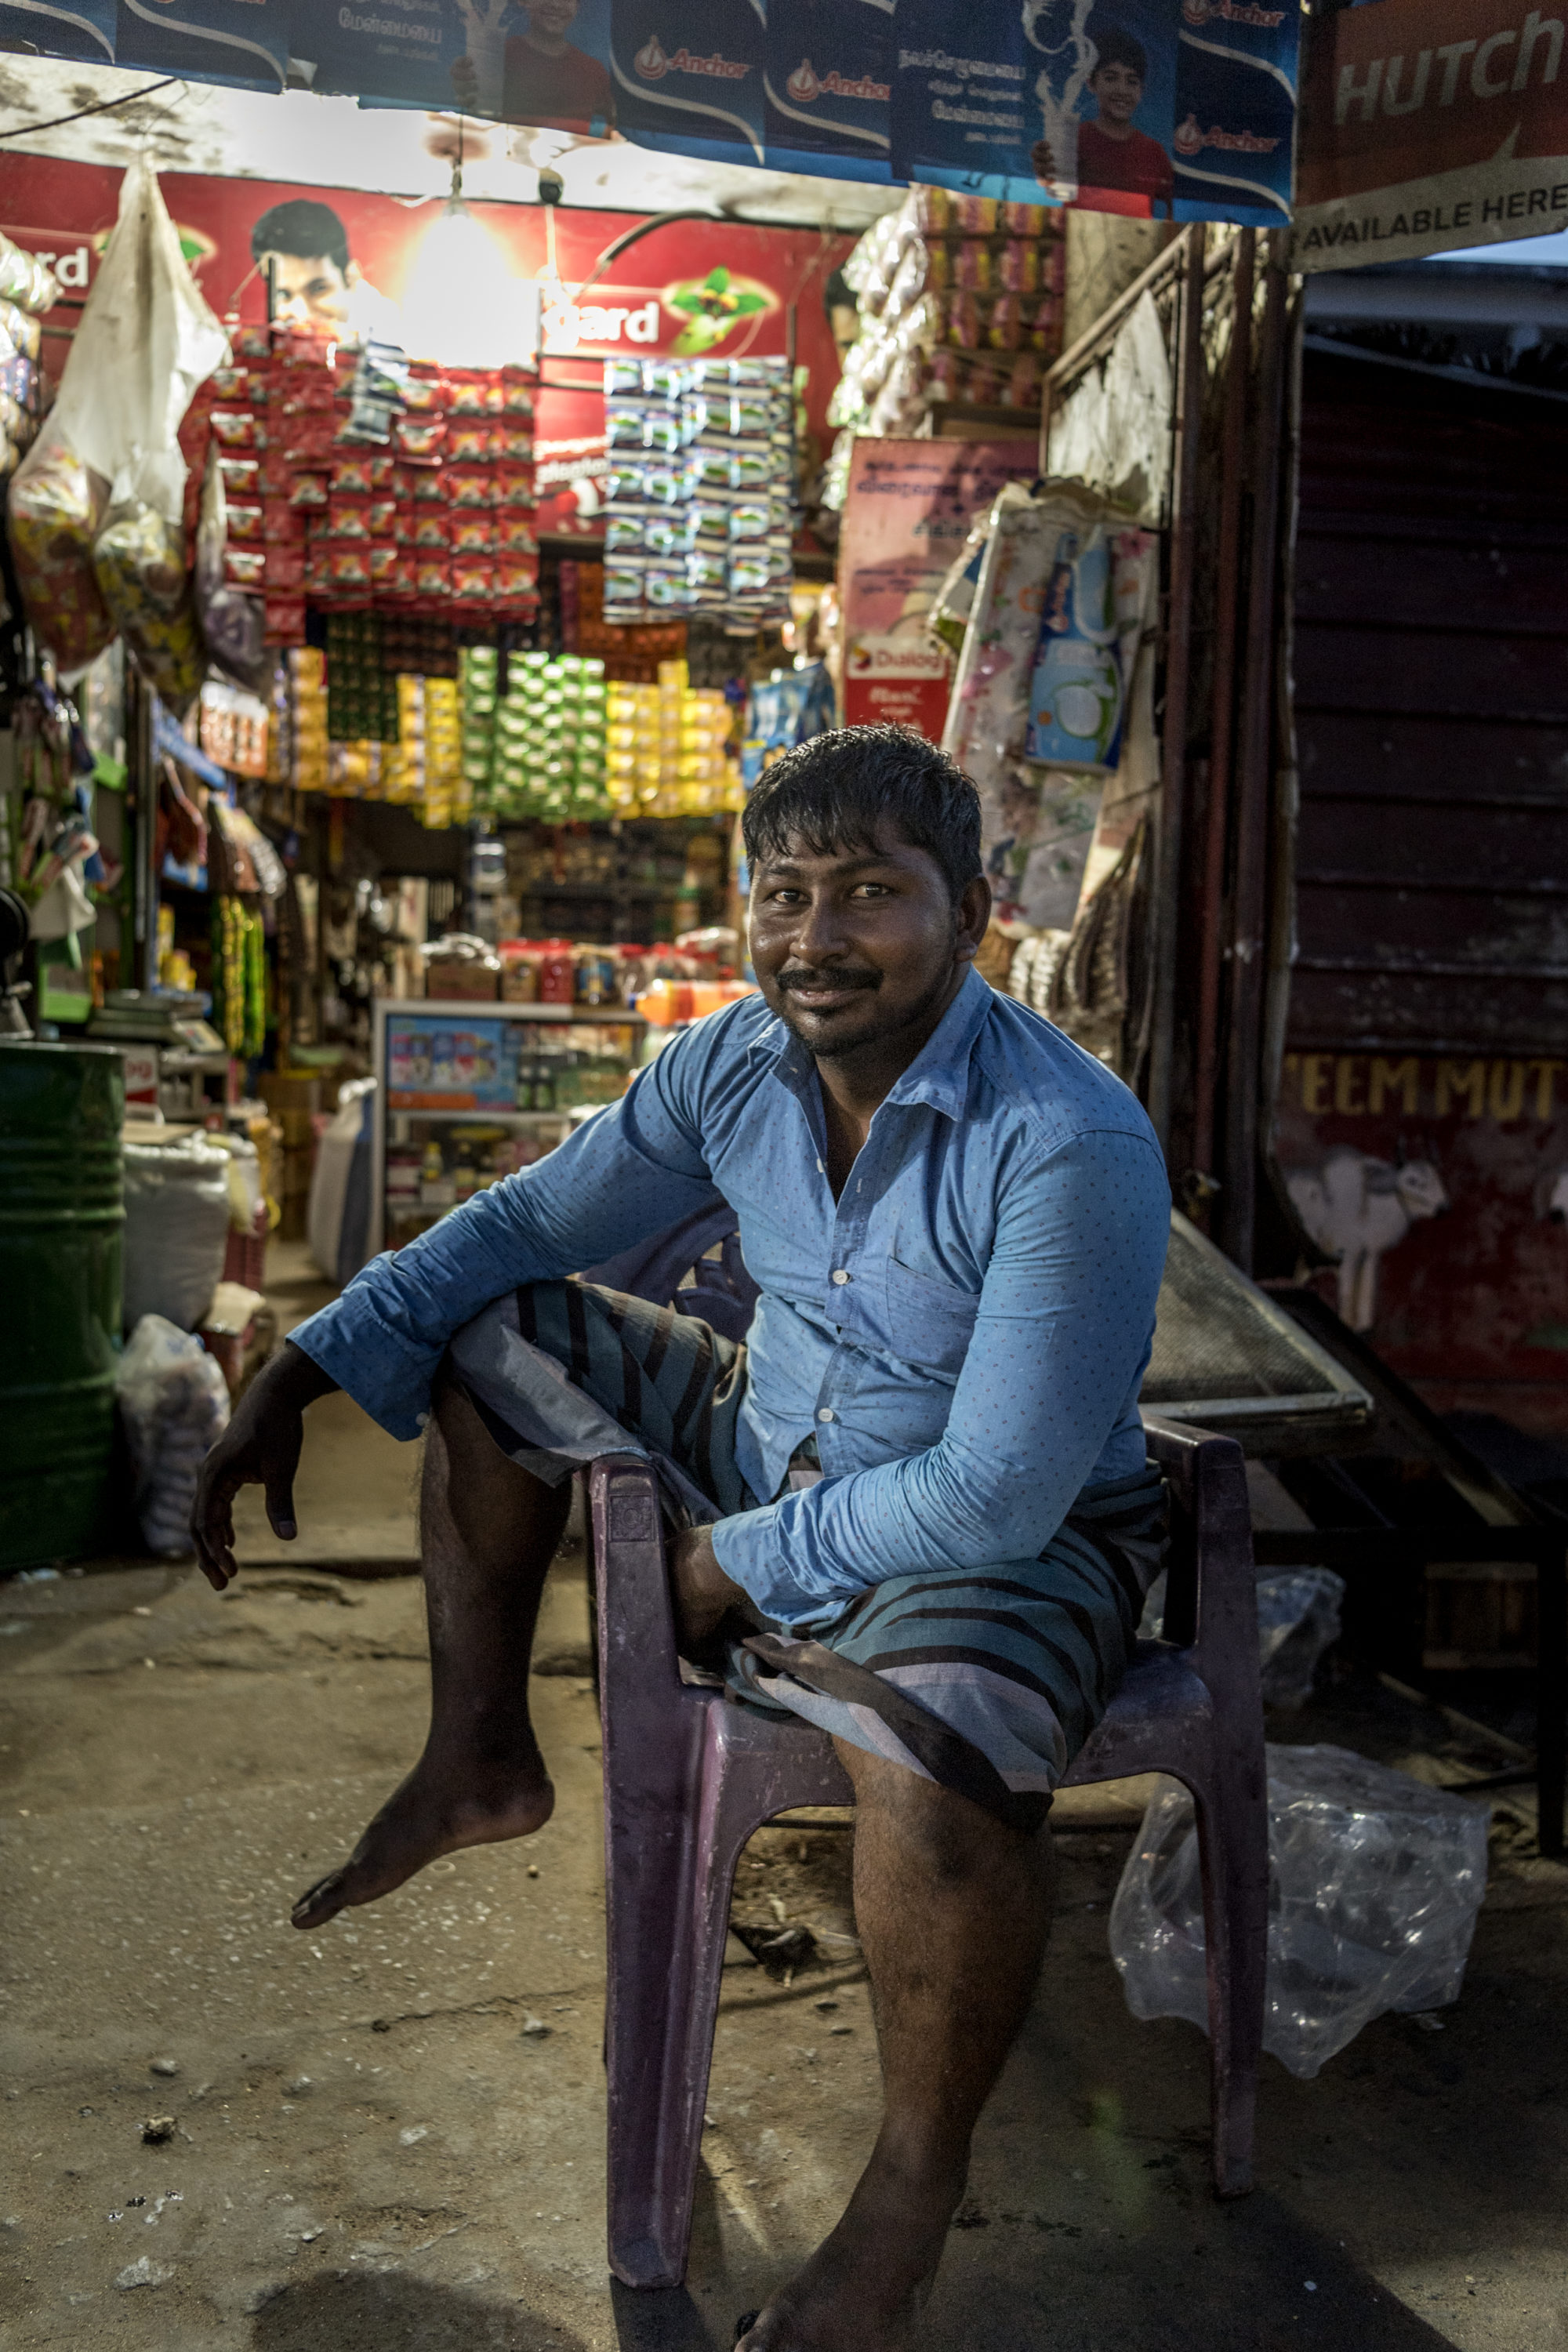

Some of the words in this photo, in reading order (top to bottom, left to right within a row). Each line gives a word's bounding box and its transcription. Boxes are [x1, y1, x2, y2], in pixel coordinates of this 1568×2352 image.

[668, 47, 751, 79] Anchor
[1205, 125, 1281, 153] Anchor
[1302, 201, 1472, 251] AVAILABLE
[1481, 183, 1568, 223] HERE
[1286, 1054, 1420, 1116] EEM
